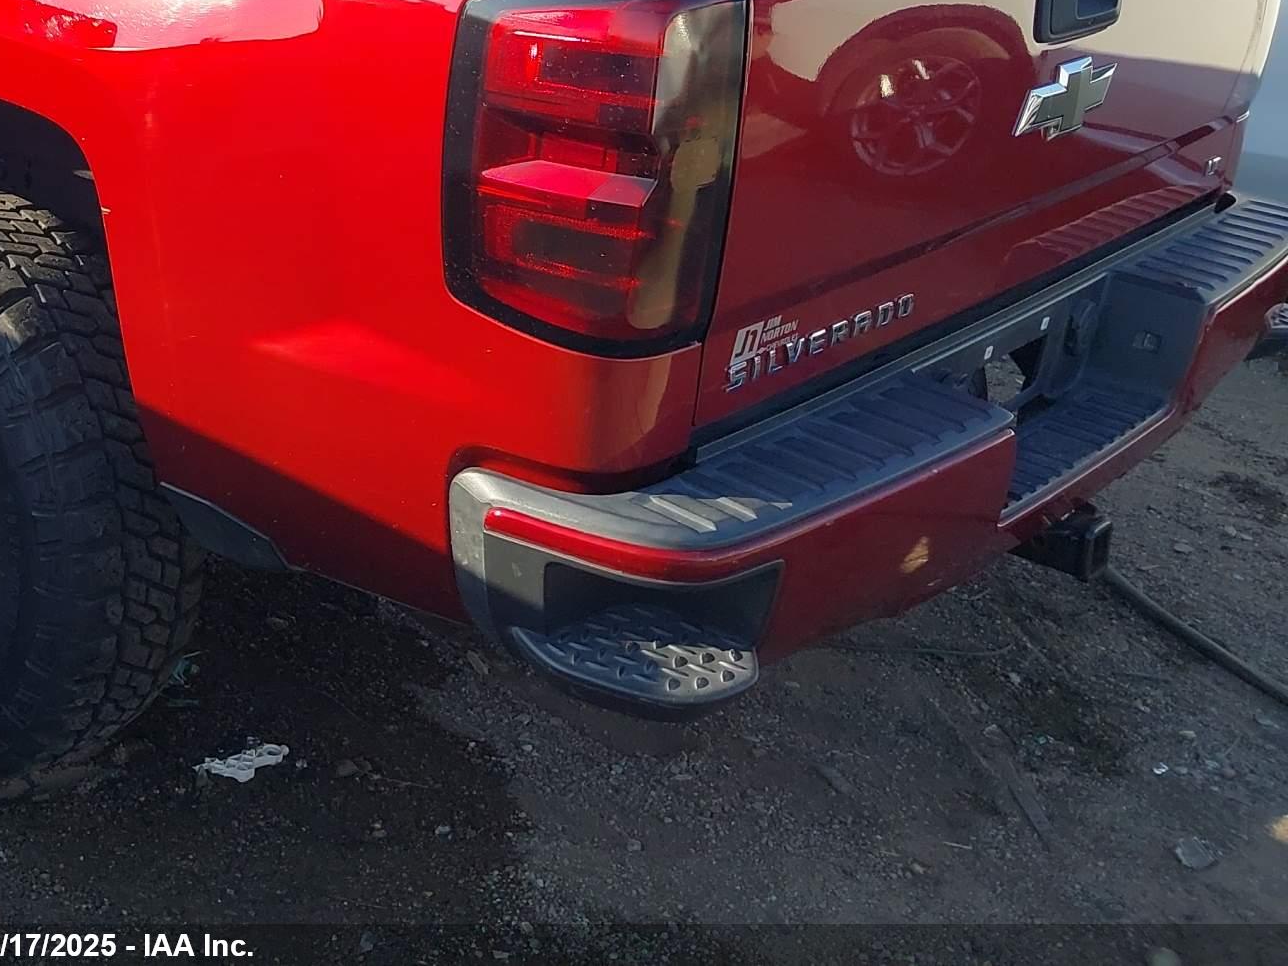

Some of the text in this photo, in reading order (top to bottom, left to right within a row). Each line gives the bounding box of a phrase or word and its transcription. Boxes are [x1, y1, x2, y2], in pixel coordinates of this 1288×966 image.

[760, 319, 800, 344] NORTON
[763, 315, 783, 332] JIM
[724, 293, 914, 392] SILVERADO
